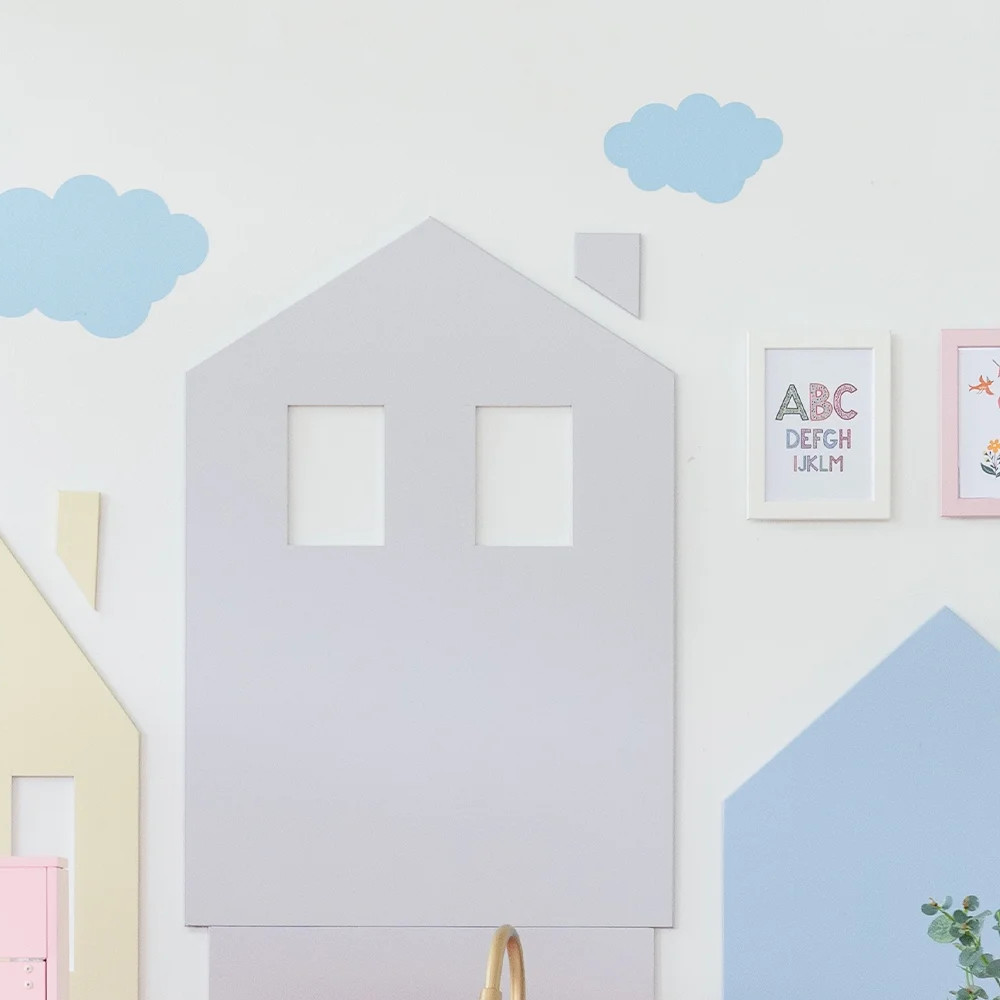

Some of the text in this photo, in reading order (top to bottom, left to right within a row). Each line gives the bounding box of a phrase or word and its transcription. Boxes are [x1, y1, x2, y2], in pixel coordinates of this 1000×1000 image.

[775, 383, 858, 421] ABC
[786, 428, 851, 449] DEFGH
[793, 455, 844, 472] IJKLM
